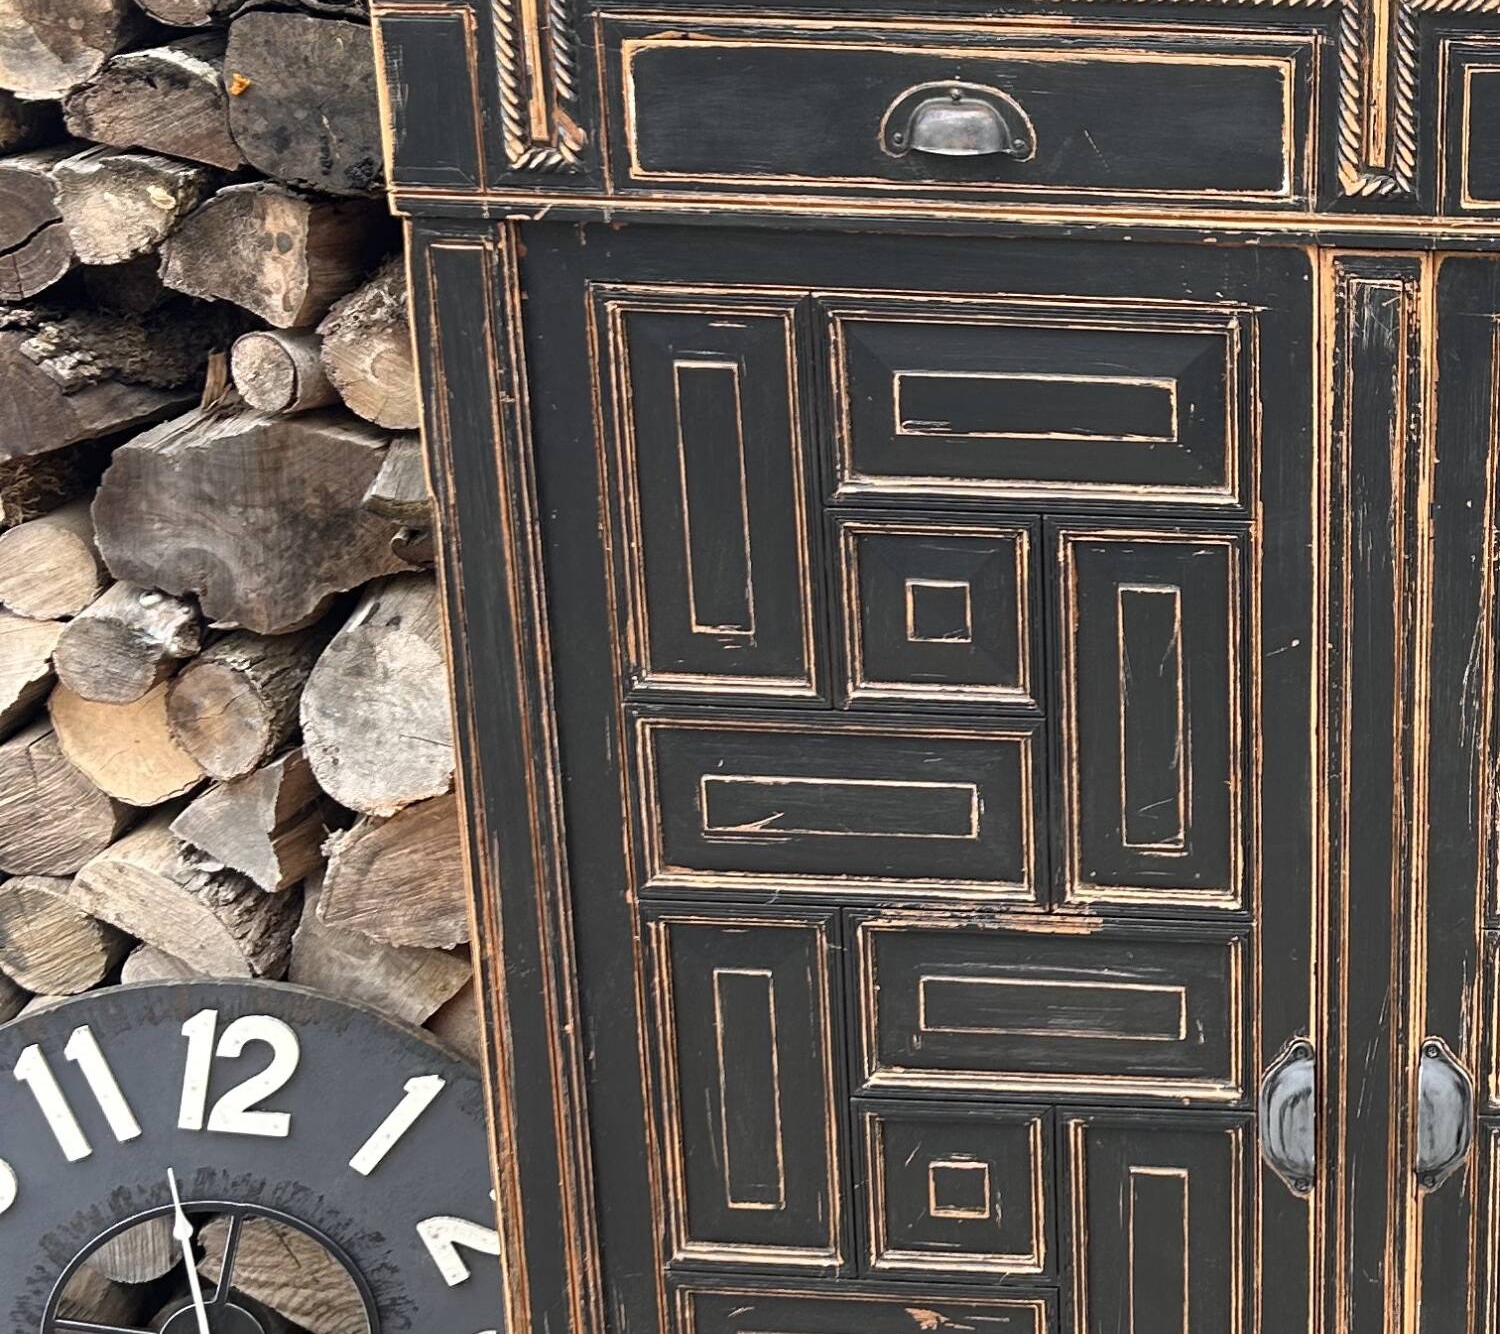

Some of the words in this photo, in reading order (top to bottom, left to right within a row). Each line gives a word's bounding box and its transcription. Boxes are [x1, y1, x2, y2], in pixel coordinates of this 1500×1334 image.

[13, 1024, 142, 1162] 11
[177, 1008, 300, 1137] 12
[348, 1074, 447, 1176] 1
